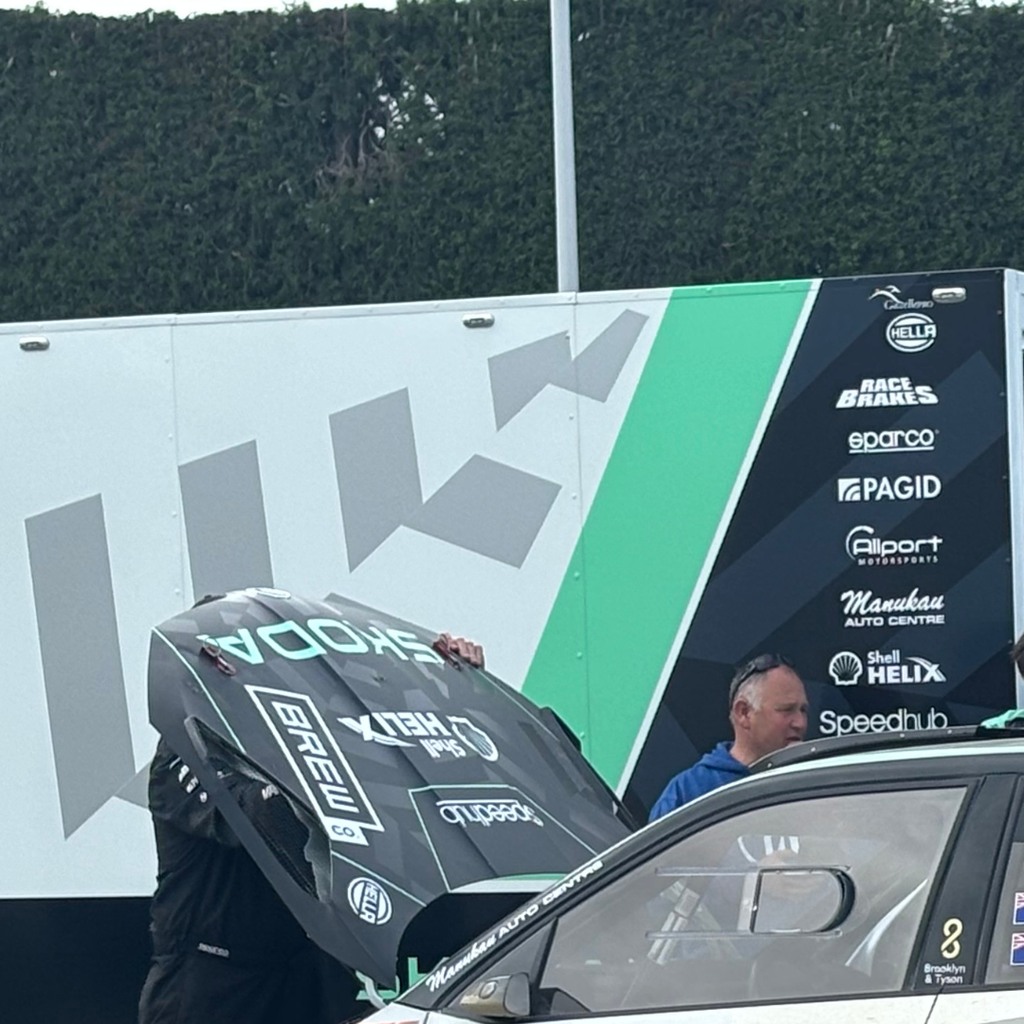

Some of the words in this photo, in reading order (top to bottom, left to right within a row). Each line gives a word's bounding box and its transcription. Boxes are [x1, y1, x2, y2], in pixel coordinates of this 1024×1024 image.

[891, 323, 937, 340] HELLA
[860, 377, 913, 393] RACE
[836, 385, 939, 408] BRAKES
[849, 429, 935, 450] sparco
[863, 475, 942, 500] PAGID
[847, 529, 943, 560] Allport
[857, 556, 939, 567] MOTORSPORTS
[840, 588, 945, 615] Manukau
[844, 616, 884, 627] AUTO
[888, 614, 945, 626] CENTRE
[867, 650, 900, 664] Shell
[868, 662, 946, 684] HELIX
[337, 712, 452, 746] HELIX
[819, 707, 948, 736] Speedhub
[271, 701, 360, 814] BREW
[419, 738, 467, 759] Shell
[439, 801, 544, 828] Speedhub
[359, 882, 380, 924] HELLA
[425, 935, 497, 992] Manukau
[499, 904, 540, 938] AUTO
[542, 860, 603, 906] CENTRE
[924, 963, 966, 977] Brooklyn
[935, 974, 964, 985] Tyson
